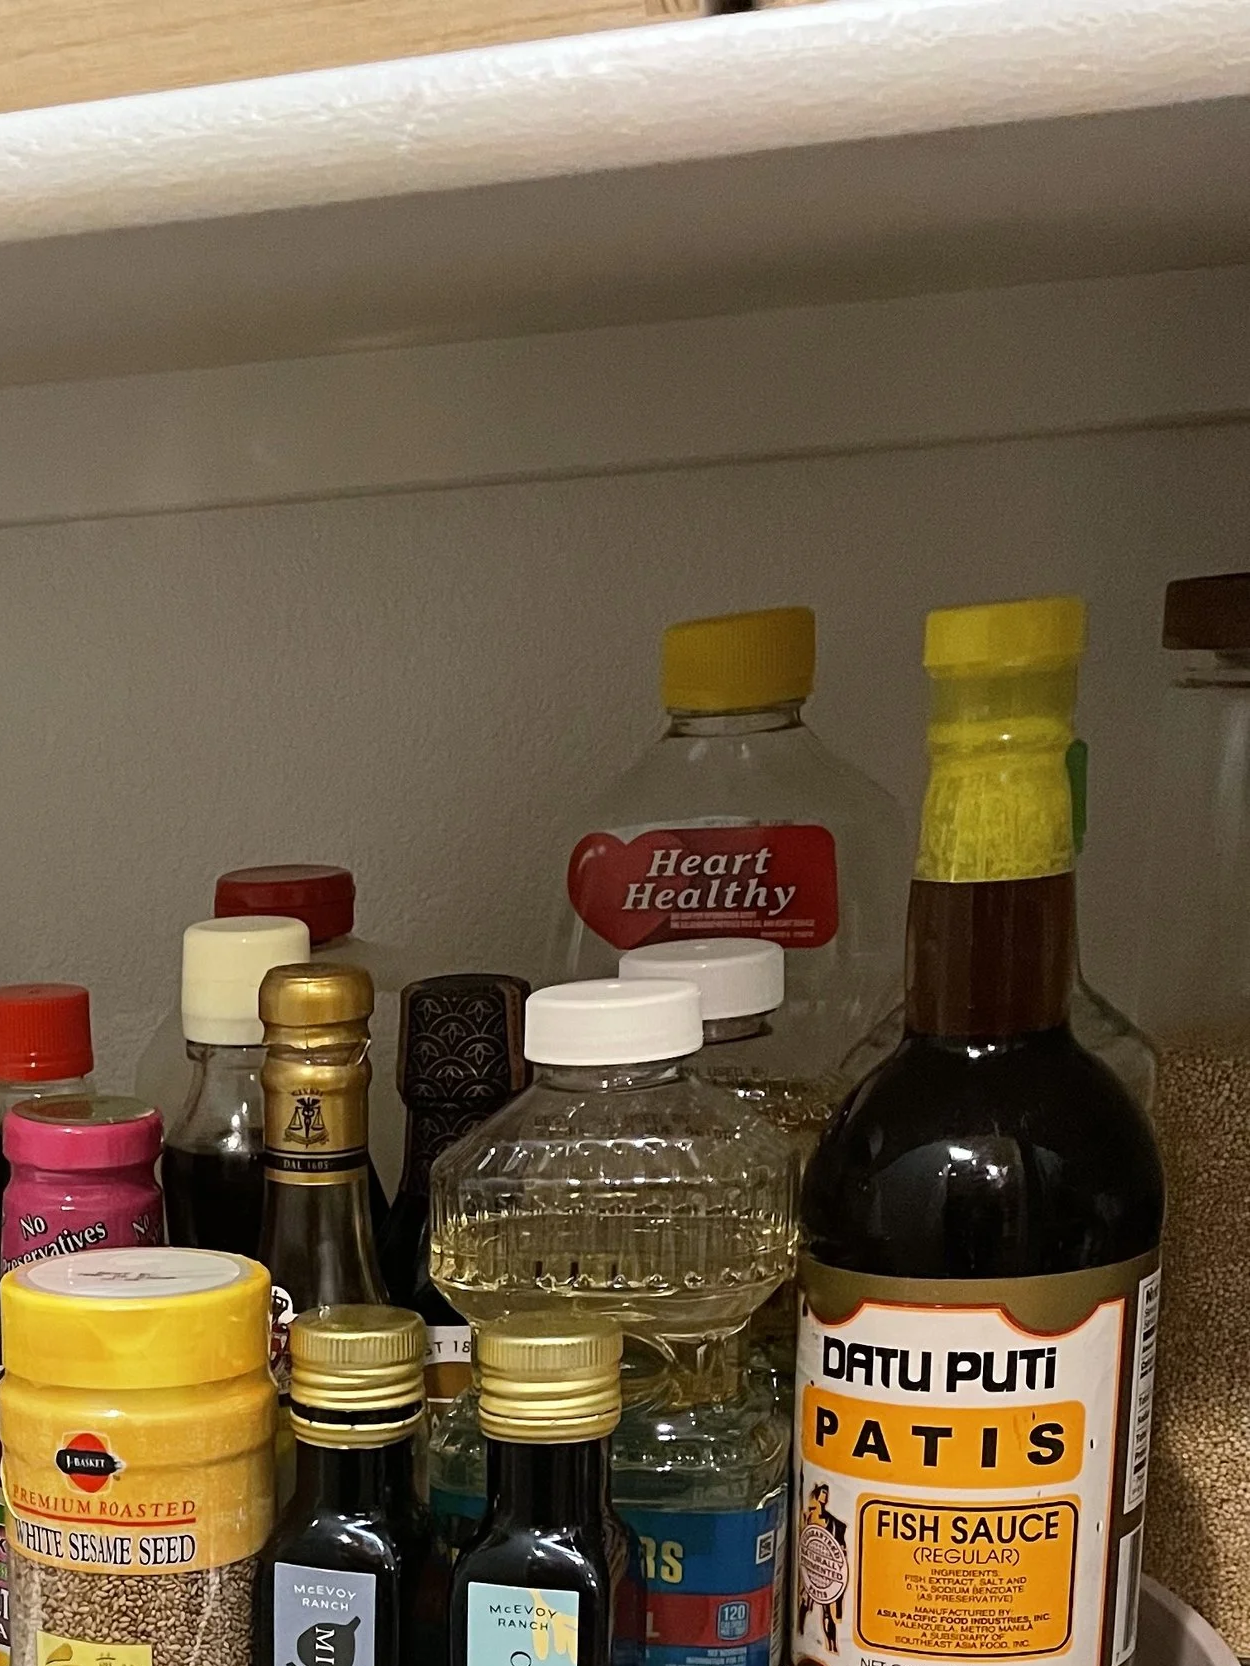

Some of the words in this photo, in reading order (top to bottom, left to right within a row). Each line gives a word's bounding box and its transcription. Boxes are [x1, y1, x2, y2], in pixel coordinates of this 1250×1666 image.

[646, 847, 773, 878] Heart
[621, 878, 796, 916] Healthy
[20, 1215, 46, 1240] No
[822, 1335, 932, 1392] DATU
[13, 1484, 91, 1514] PREMIUM
[100, 1500, 195, 1517] ROASTED
[877, 1510, 939, 1543] FISH
[950, 1511, 1060, 1545] SAUCE
[15, 1518, 64, 1558] WHITE
[69, 1533, 131, 1565] SESAME
[139, 1534, 195, 1566] SEED
[913, 1547, 1020, 1566] (REGULAR)
[930, 1585, 970, 1594] SODIUM
[972, 1585, 1024, 1594] BENZOATE
[979, 1578, 1003, 1586] SALT
[1006, 1576, 1027, 1585] AND
[294, 1584, 356, 1602] McEVOY
[302, 1597, 349, 1611] RANCH
[489, 1604, 557, 1620] McEVOY
[724, 1605, 746, 1620] 120
[914, 1606, 996, 1617] MANUFACTURED
[498, 1617, 549, 1631] RANCH
[876, 1608, 898, 1619] ASIA
[900, 1612, 937, 1624] PACIFIC
[940, 1616, 968, 1625] FOOD
[954, 1641, 977, 1649] ASIA
